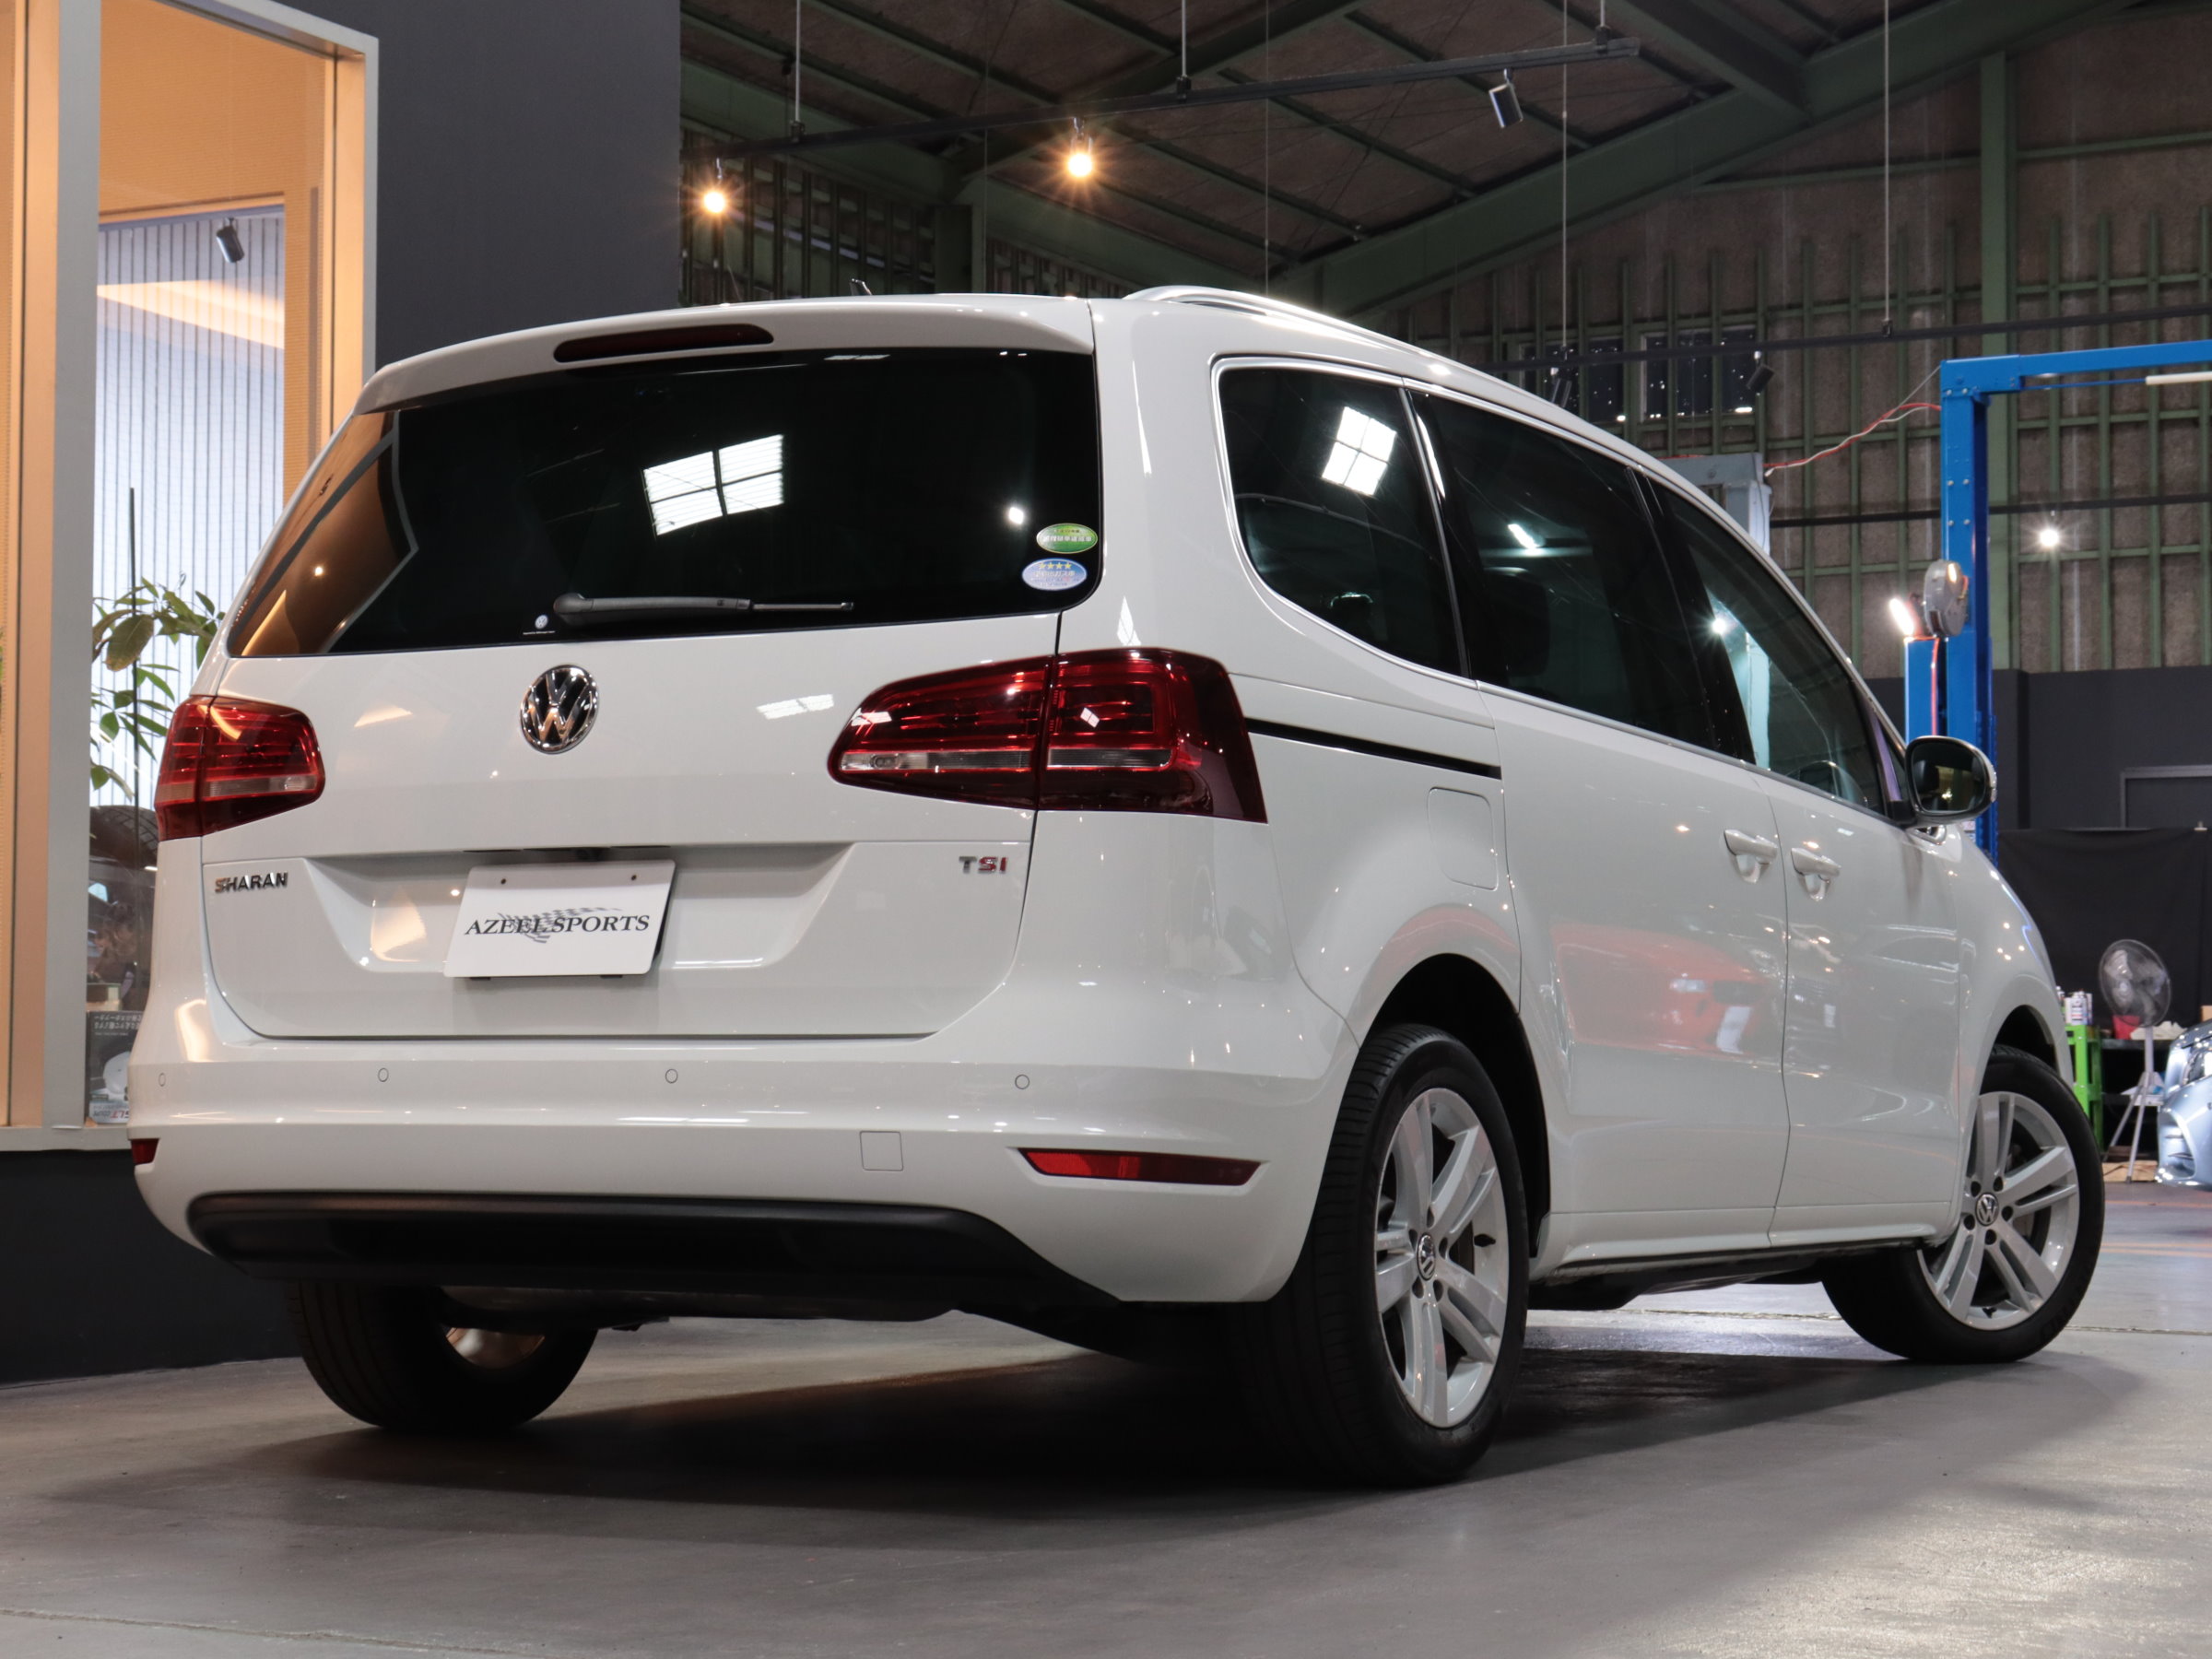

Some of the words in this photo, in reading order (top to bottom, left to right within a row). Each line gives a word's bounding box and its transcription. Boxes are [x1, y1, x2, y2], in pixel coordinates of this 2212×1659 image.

[523, 666, 596, 749] VW
[959, 855, 1007, 875] TSI
[214, 872, 288, 894] SHARAN
[553, 915, 650, 933] SPORTS
